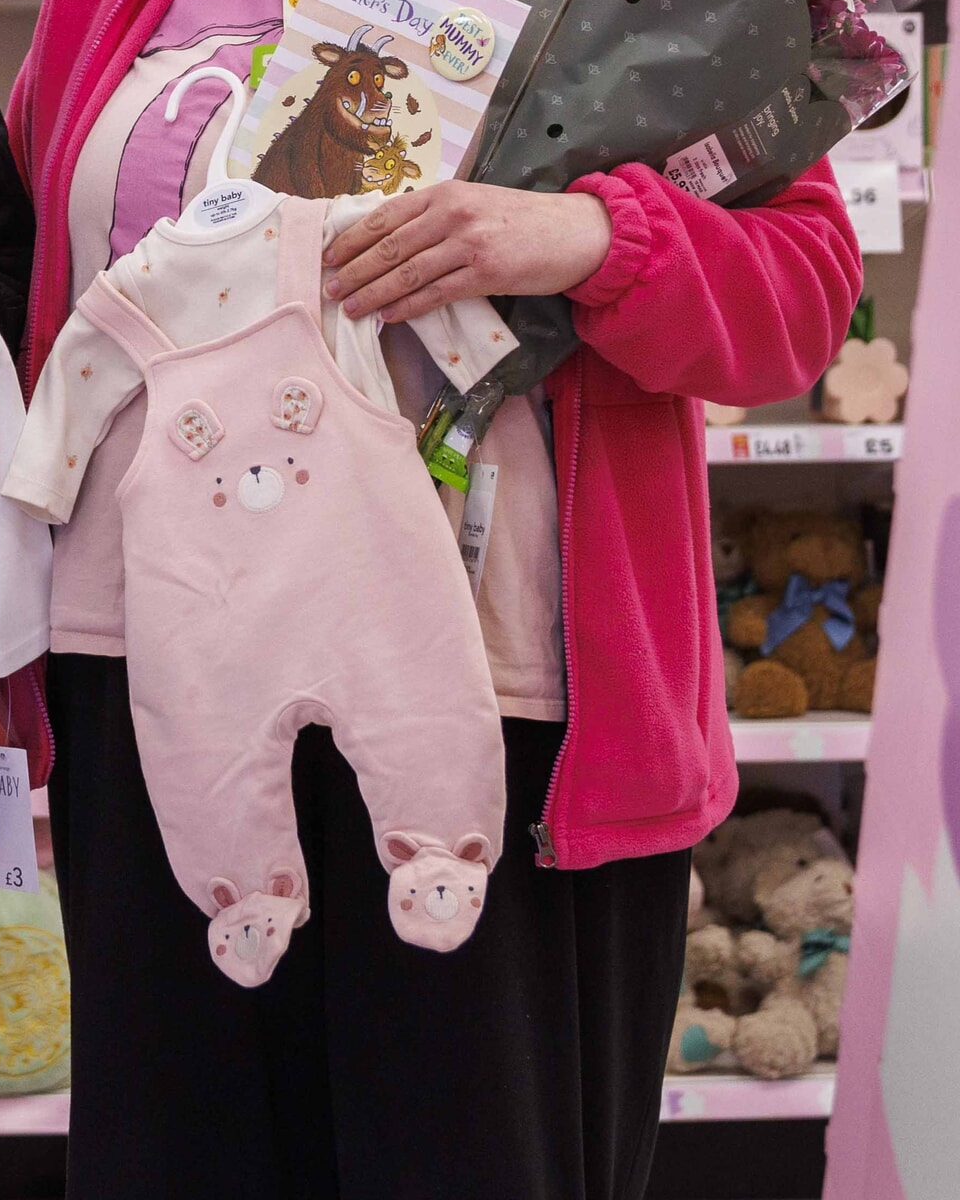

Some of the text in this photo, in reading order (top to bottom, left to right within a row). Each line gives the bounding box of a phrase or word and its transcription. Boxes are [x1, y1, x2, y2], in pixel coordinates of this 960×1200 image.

[454, 13, 485, 37] BEST
[439, 17, 484, 66] MUMMY
[442, 49, 470, 75] EVER!
[763, 104, 780, 137] bringing
[203, 191, 242, 208] tiny baby
[5, 866, 23, 887] £3
